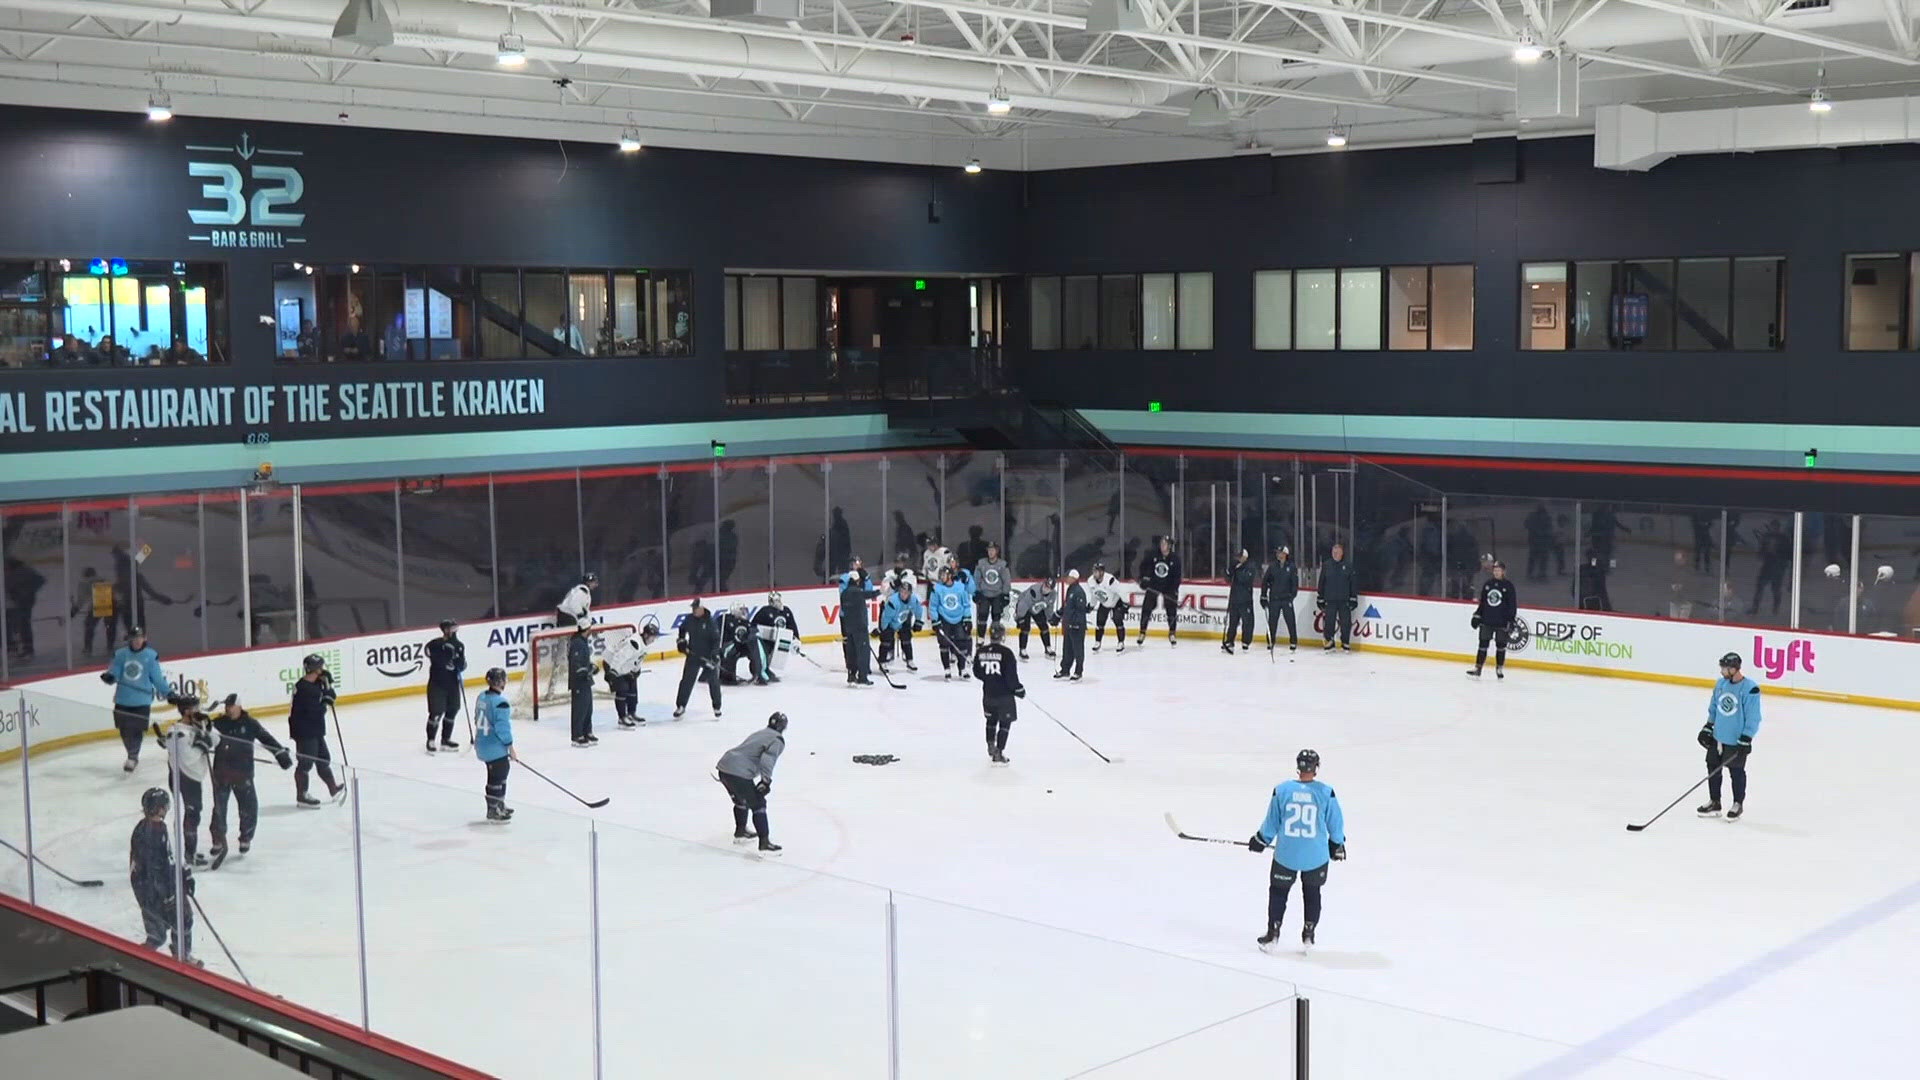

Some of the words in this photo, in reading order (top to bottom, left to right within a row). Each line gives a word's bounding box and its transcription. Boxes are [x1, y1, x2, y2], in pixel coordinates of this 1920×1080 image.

[187, 162, 306, 227] 32
[45, 387, 235, 432] RESTAURANT
[243, 386, 275, 425] OF
[282, 384, 331, 423] THE
[339, 381, 446, 420] SEATTLE
[452, 378, 545, 416] KRAKEN
[1375, 623, 1431, 643] LIGHT
[1535, 621, 1577, 640] DEPT
[1580, 625, 1603, 641] OF
[366, 643, 431, 666] amaz
[1535, 637, 1633, 659] IMAGINATION
[1753, 635, 1816, 680] lyft
[1283, 803, 1318, 839] 29
